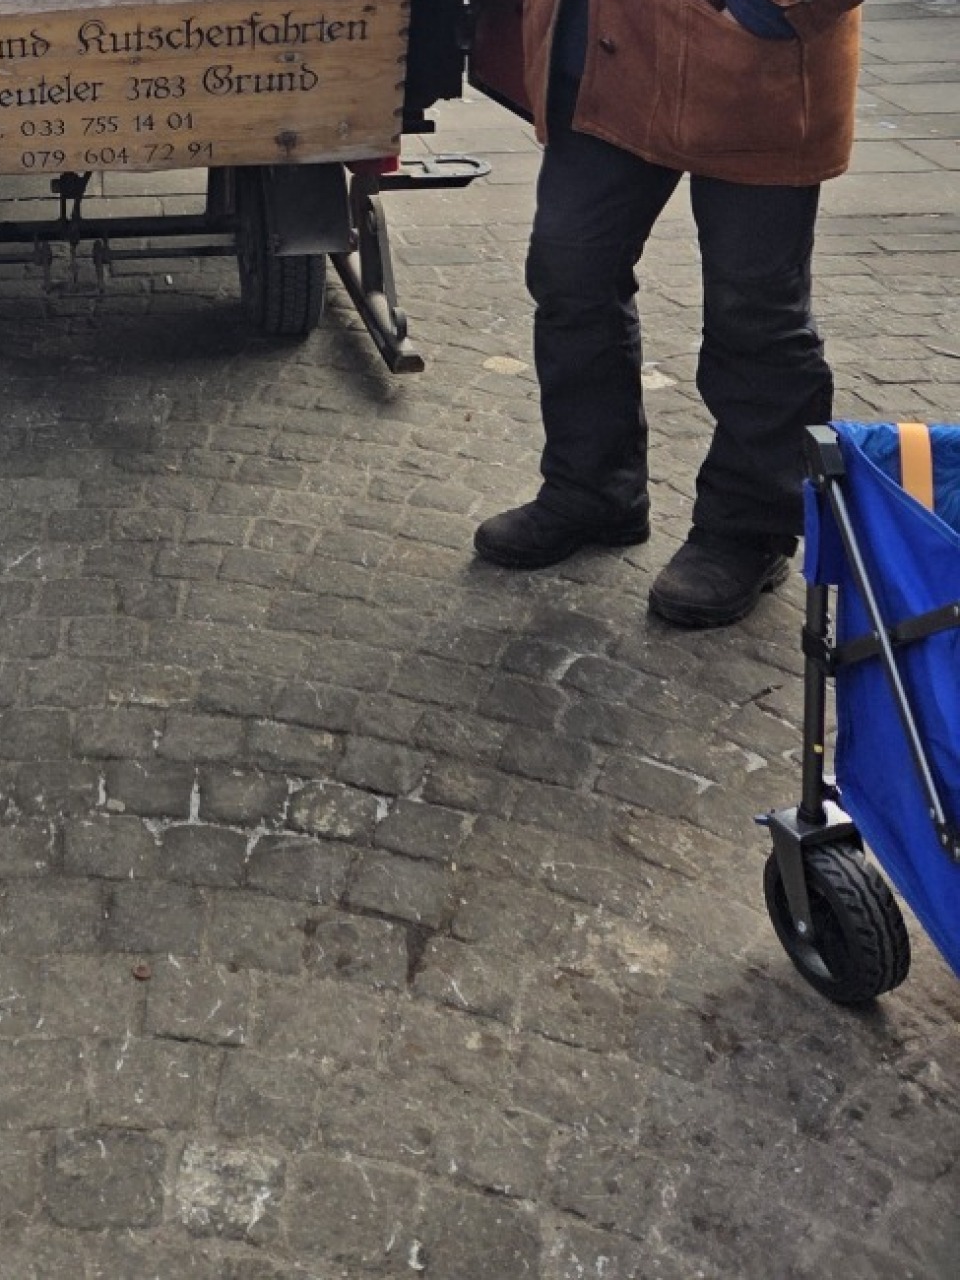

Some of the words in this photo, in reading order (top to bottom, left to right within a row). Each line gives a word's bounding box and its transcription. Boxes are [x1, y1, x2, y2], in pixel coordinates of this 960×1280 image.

[77, 11, 368, 54] Kutschenfahrten
[126, 76, 187, 101] 3783
[201, 64, 319, 95] Grund
[20, 119, 66, 137] 033
[81, 115, 119, 135] 755
[134, 113, 155, 132] 14
[166, 112, 195, 131] 01
[21, 150, 66, 169] 079
[83, 145, 130, 165] 604
[144, 143, 175, 161] 72
[187, 142, 214, 159] 91
